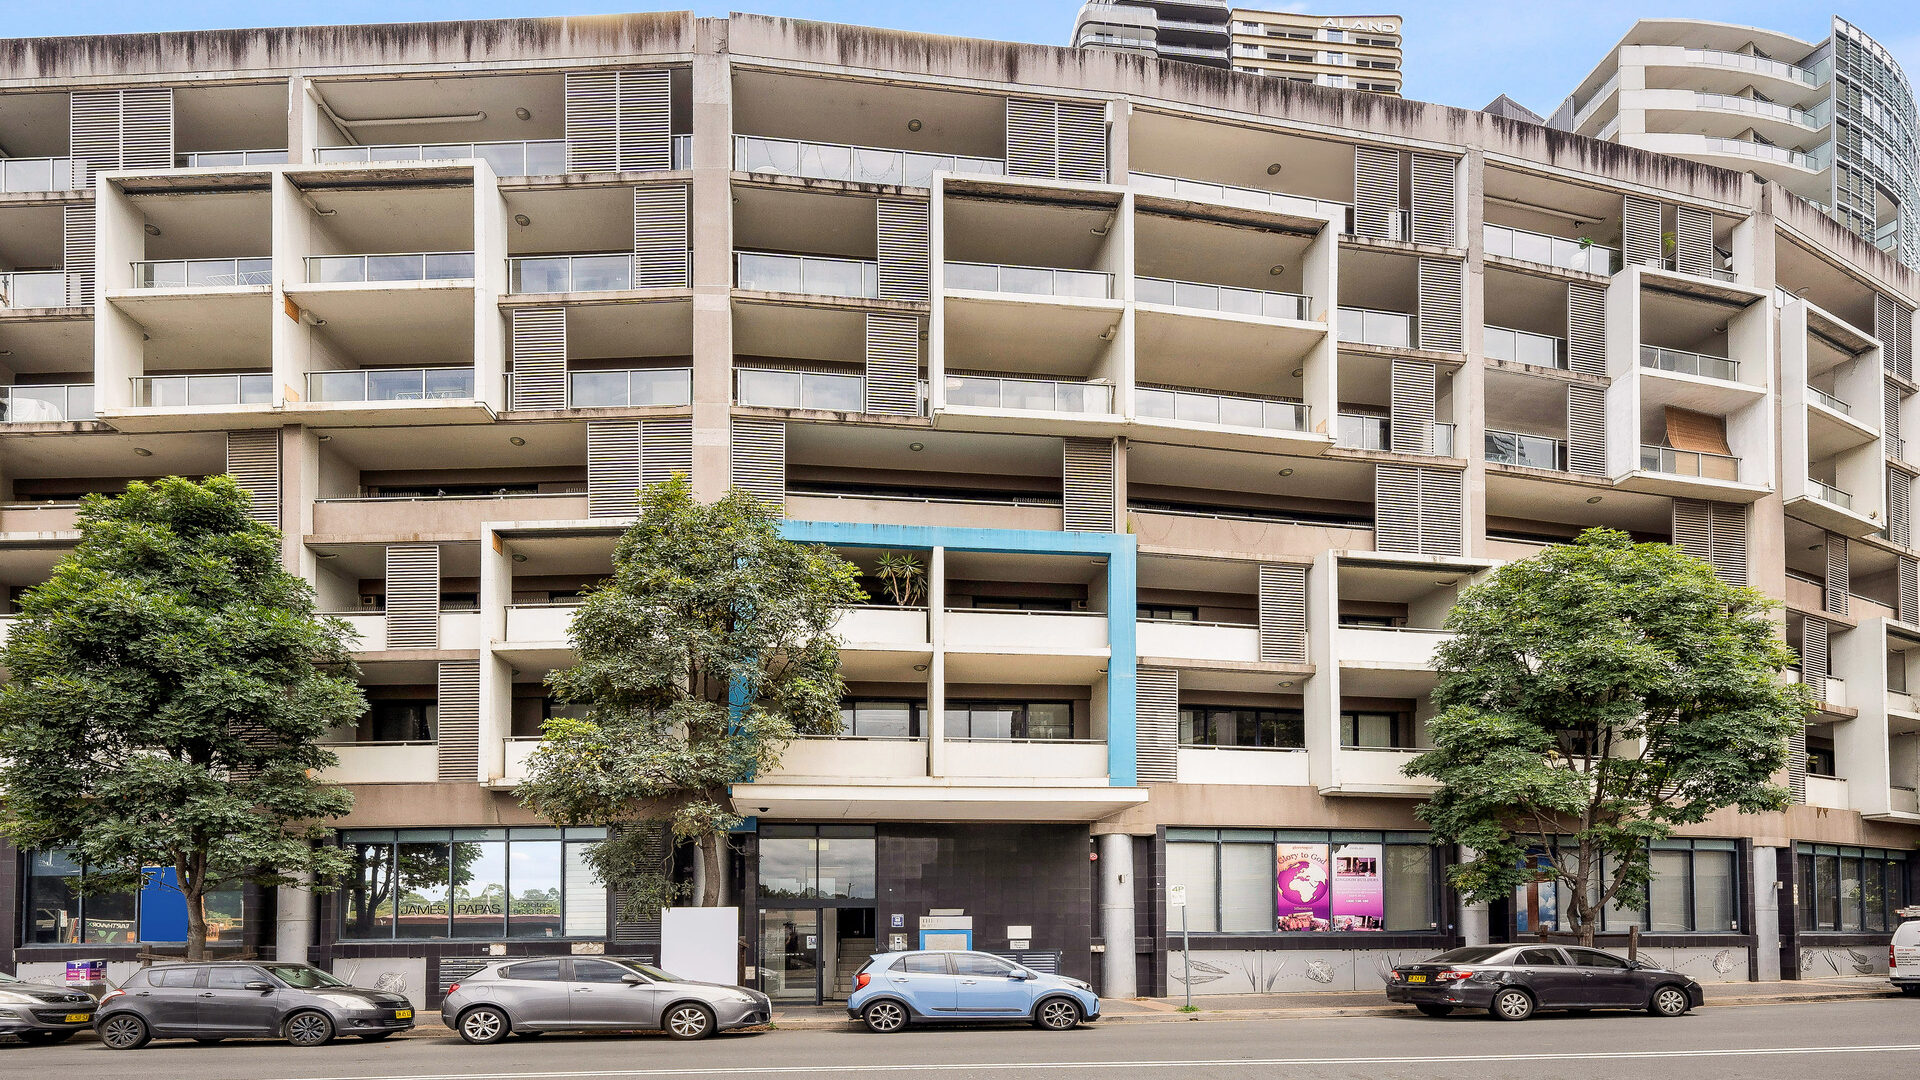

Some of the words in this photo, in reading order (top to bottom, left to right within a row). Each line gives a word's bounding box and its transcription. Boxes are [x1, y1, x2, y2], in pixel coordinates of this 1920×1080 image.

[1321, 17, 1397, 33] ALAND
[1278, 853, 1298, 864] Glory
[1310, 853, 1327, 864] God
[400, 904, 446, 915] JAMES
[457, 903, 500, 915] PAPAS
[75, 961, 82, 969] P
